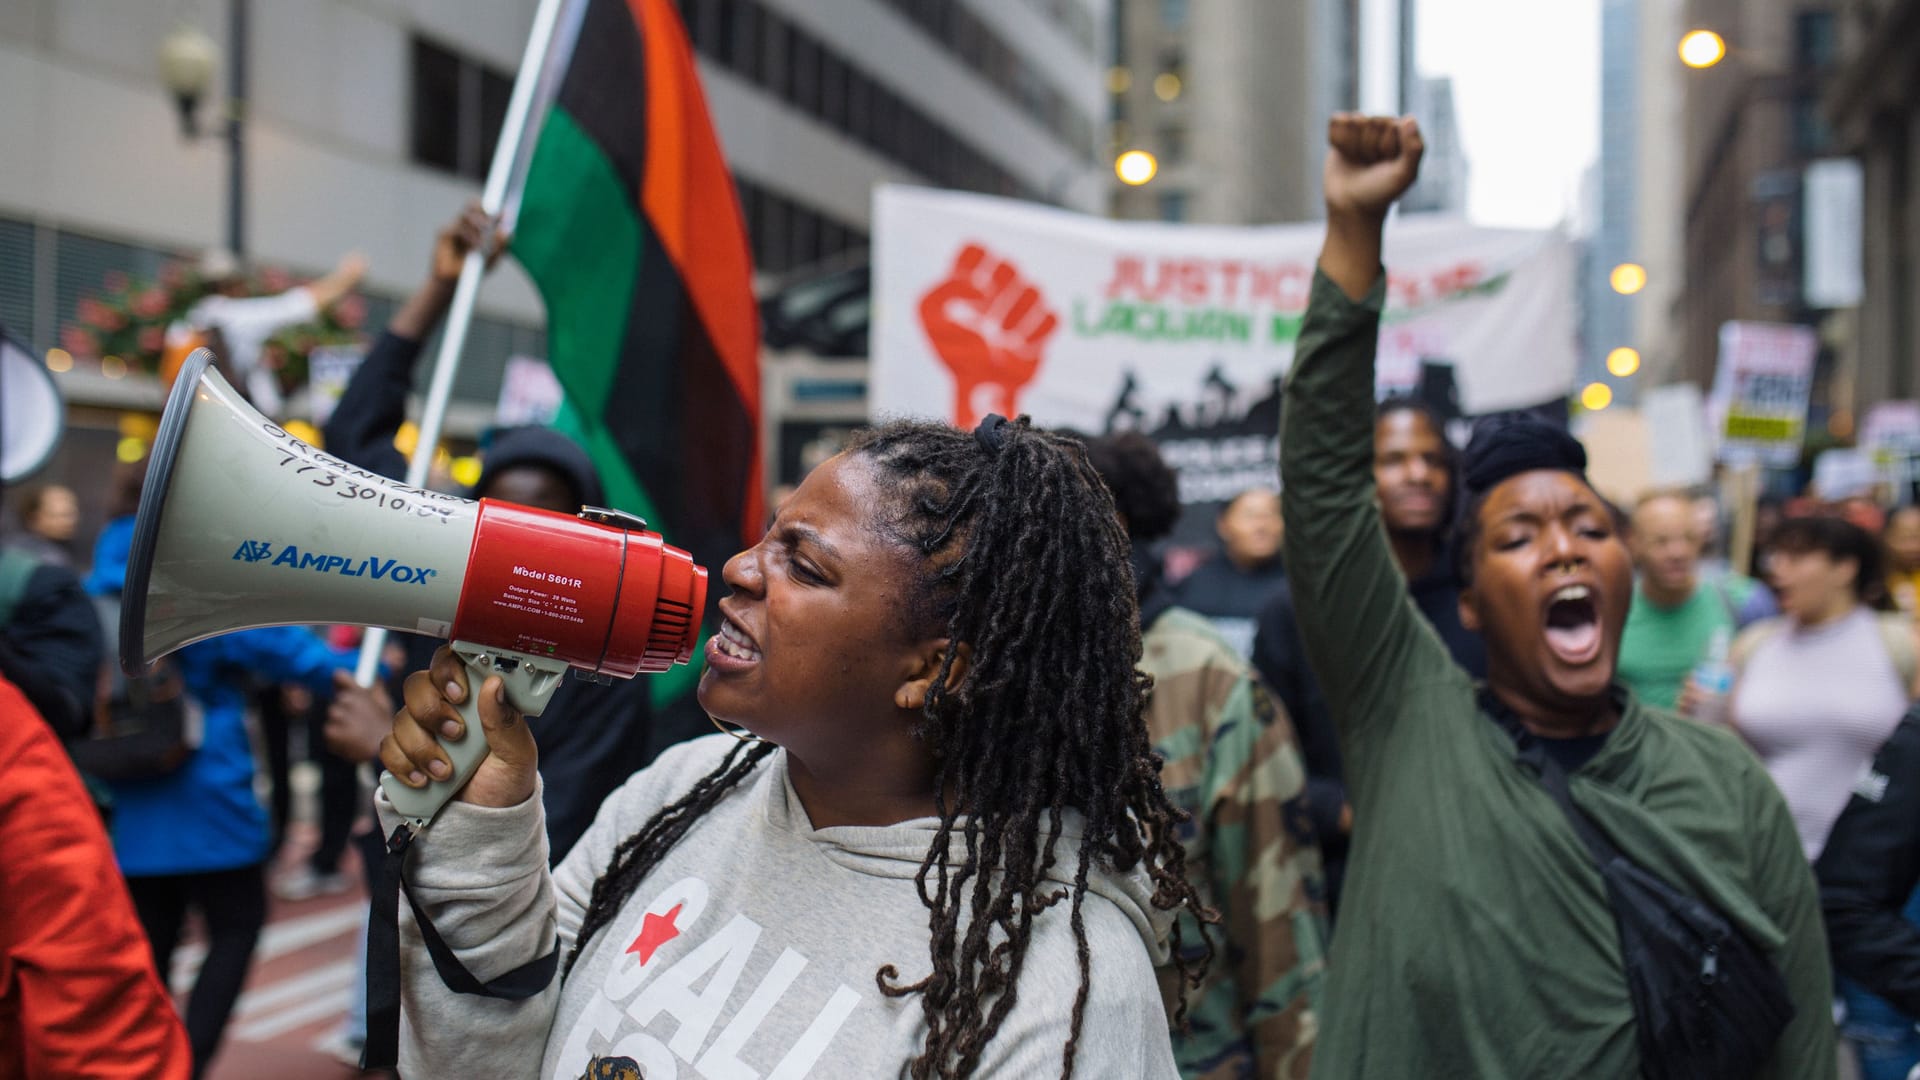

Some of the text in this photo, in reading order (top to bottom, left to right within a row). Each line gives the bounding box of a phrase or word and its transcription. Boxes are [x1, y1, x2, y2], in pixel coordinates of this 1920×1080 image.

[1103, 253, 1314, 313] JUSTIC
[1073, 296, 1252, 342] LAQUAN
[508, 584, 529, 595] Output
[512, 565, 582, 588] Model S601R
